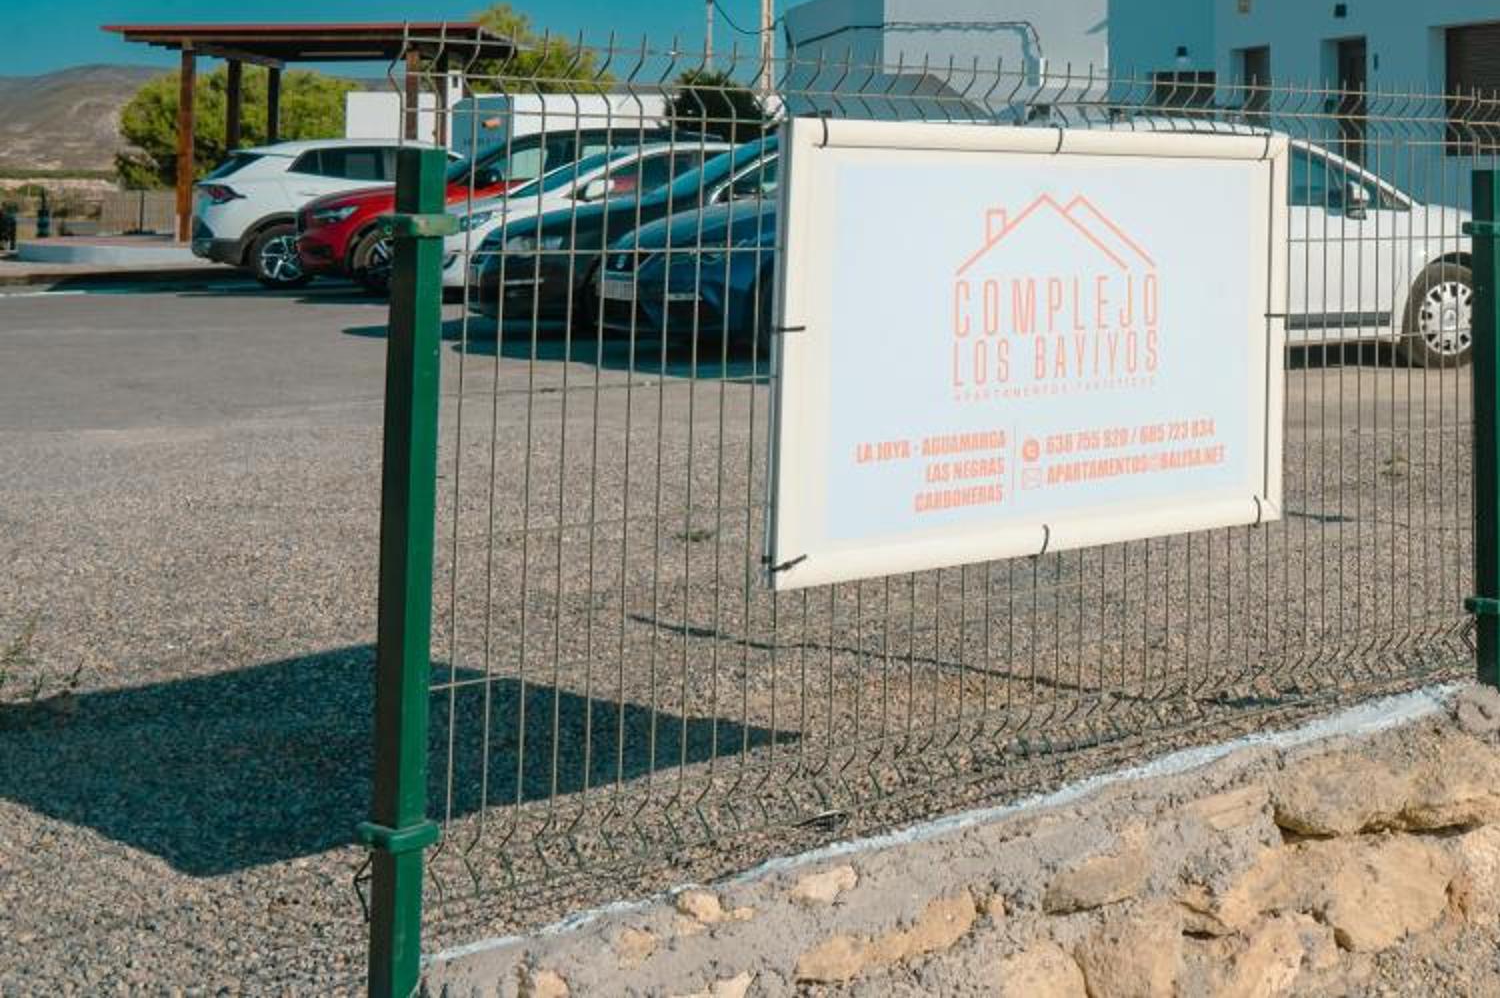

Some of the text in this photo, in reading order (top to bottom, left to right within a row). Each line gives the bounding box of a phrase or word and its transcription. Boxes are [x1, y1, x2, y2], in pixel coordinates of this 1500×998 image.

[954, 273, 1159, 337] COMPLEJO
[953, 338, 1009, 387] LOS
[856, 442, 873, 464] LA
[926, 457, 1005, 483] LAS NEGRAS
[914, 483, 1003, 513] CARBONERAS
